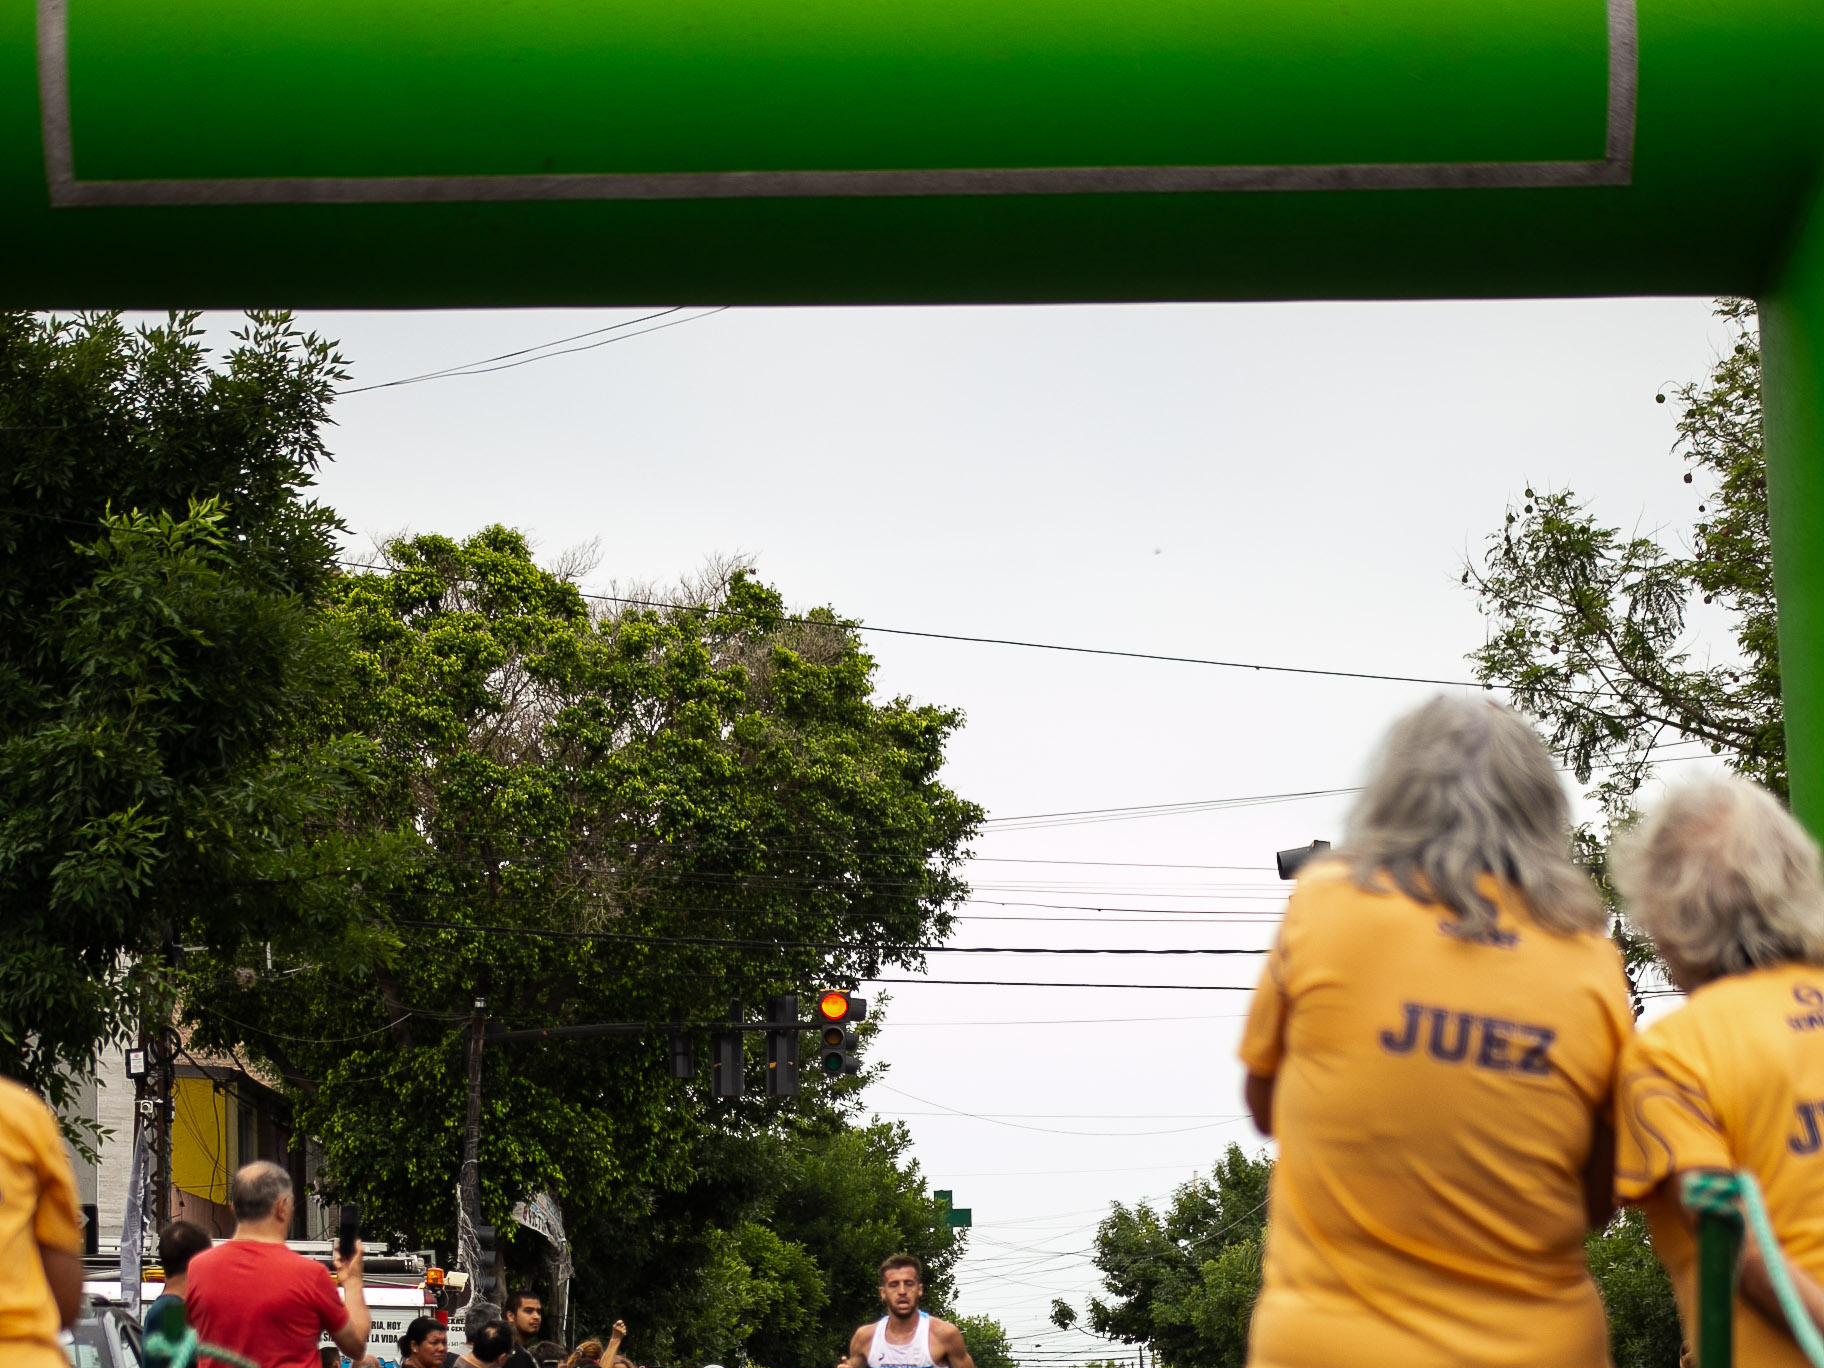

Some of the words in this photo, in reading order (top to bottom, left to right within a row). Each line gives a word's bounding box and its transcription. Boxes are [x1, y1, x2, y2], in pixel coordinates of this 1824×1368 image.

[1379, 1002, 1556, 1076] JUEZ
[387, 1321, 402, 1330] HOY
[371, 1334, 380, 1343] LA
